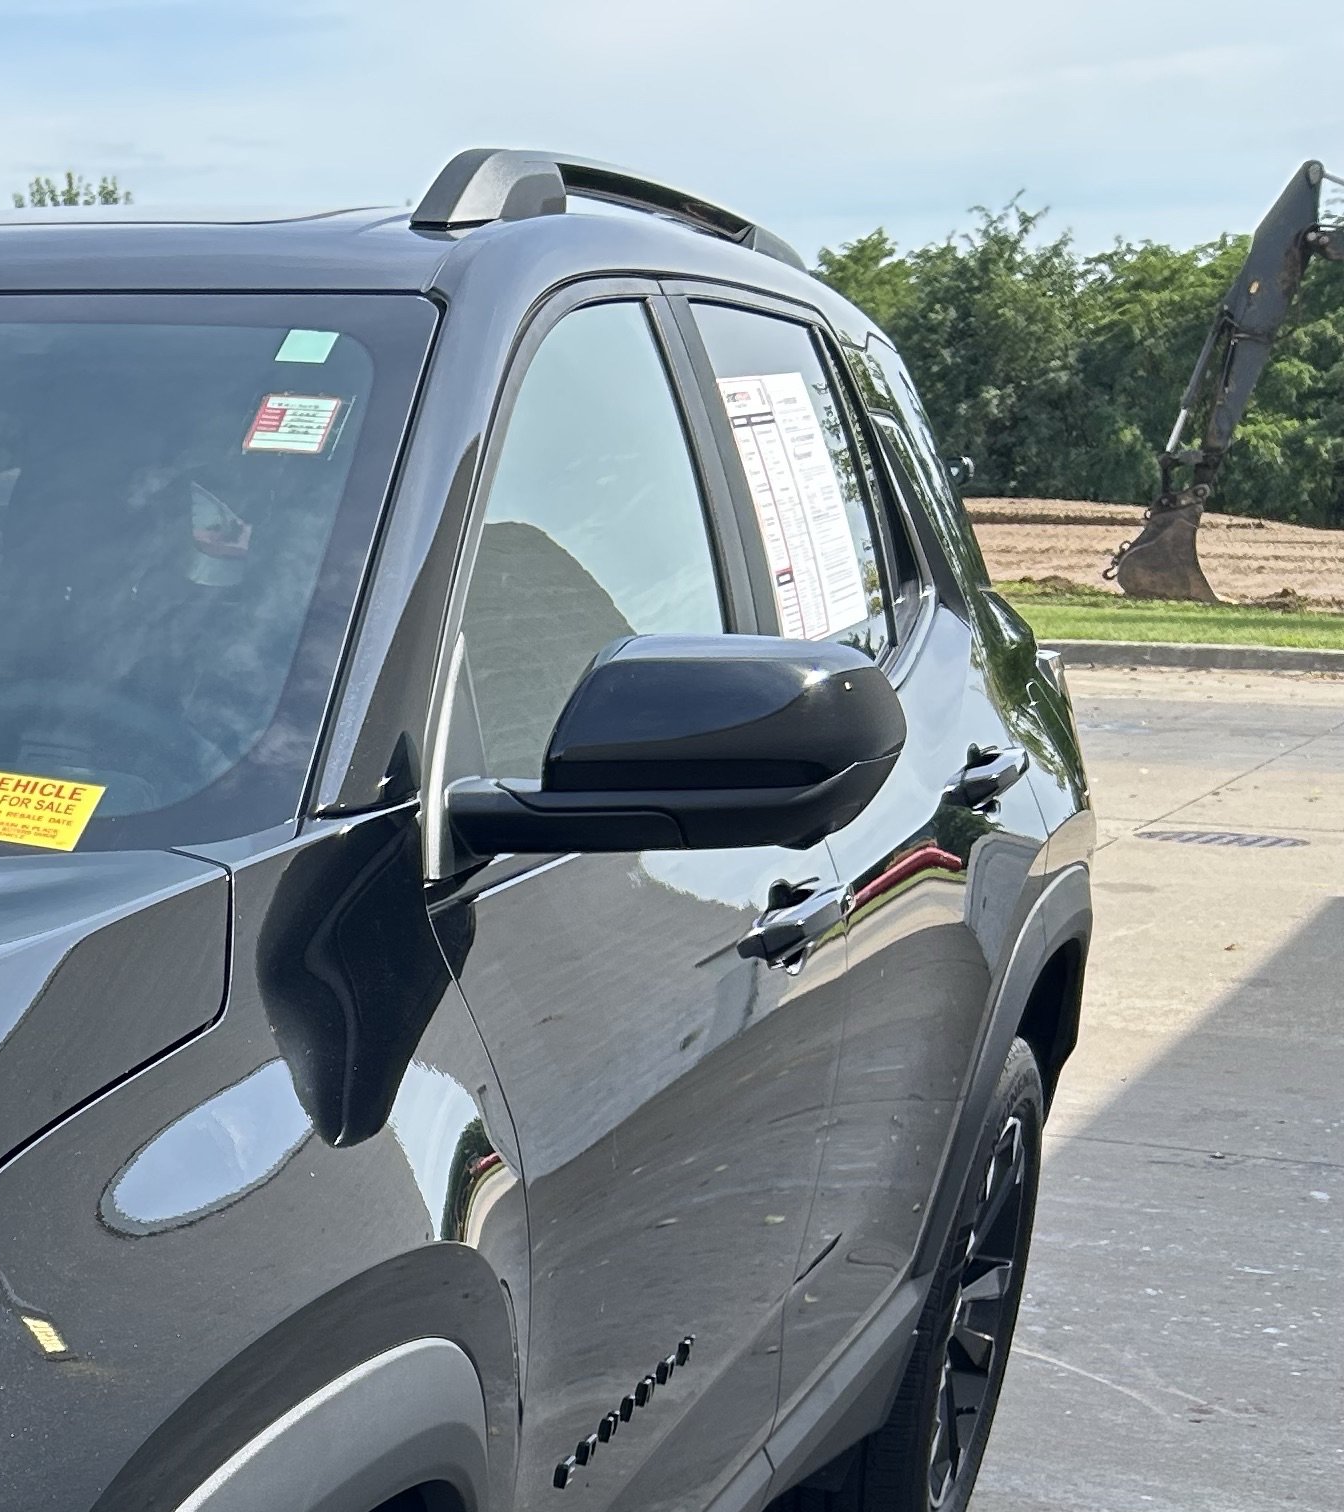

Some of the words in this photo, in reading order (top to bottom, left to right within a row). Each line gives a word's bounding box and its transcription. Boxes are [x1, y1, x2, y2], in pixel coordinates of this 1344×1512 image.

[33, 799, 76, 815] SALE
[6, 811, 44, 822] RESALE
[48, 817, 73, 827] DATE
